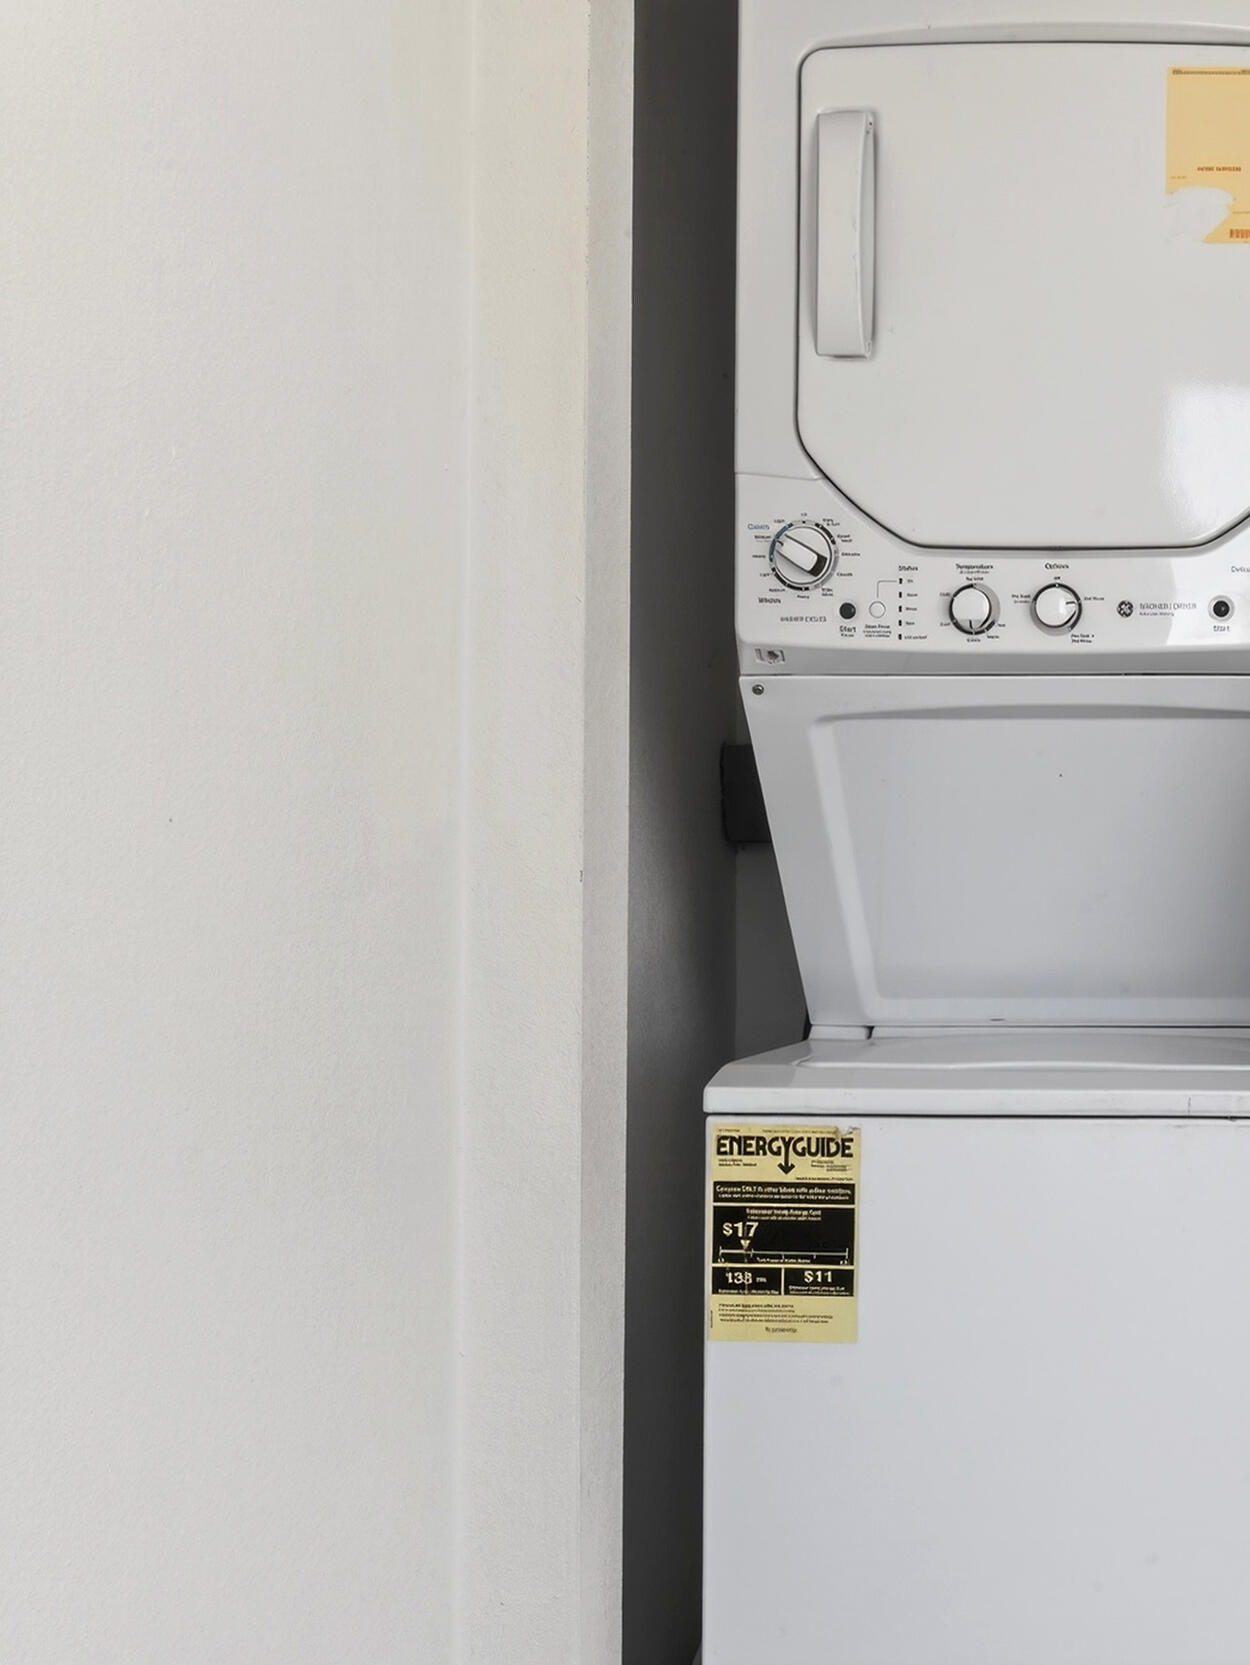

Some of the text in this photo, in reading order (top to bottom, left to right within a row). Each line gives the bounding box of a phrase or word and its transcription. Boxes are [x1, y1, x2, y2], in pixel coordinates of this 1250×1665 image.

[716, 1134, 854, 1160] ENERGYGUIDE
[722, 1221, 759, 1238] $17
[803, 1270, 833, 1283] $11
